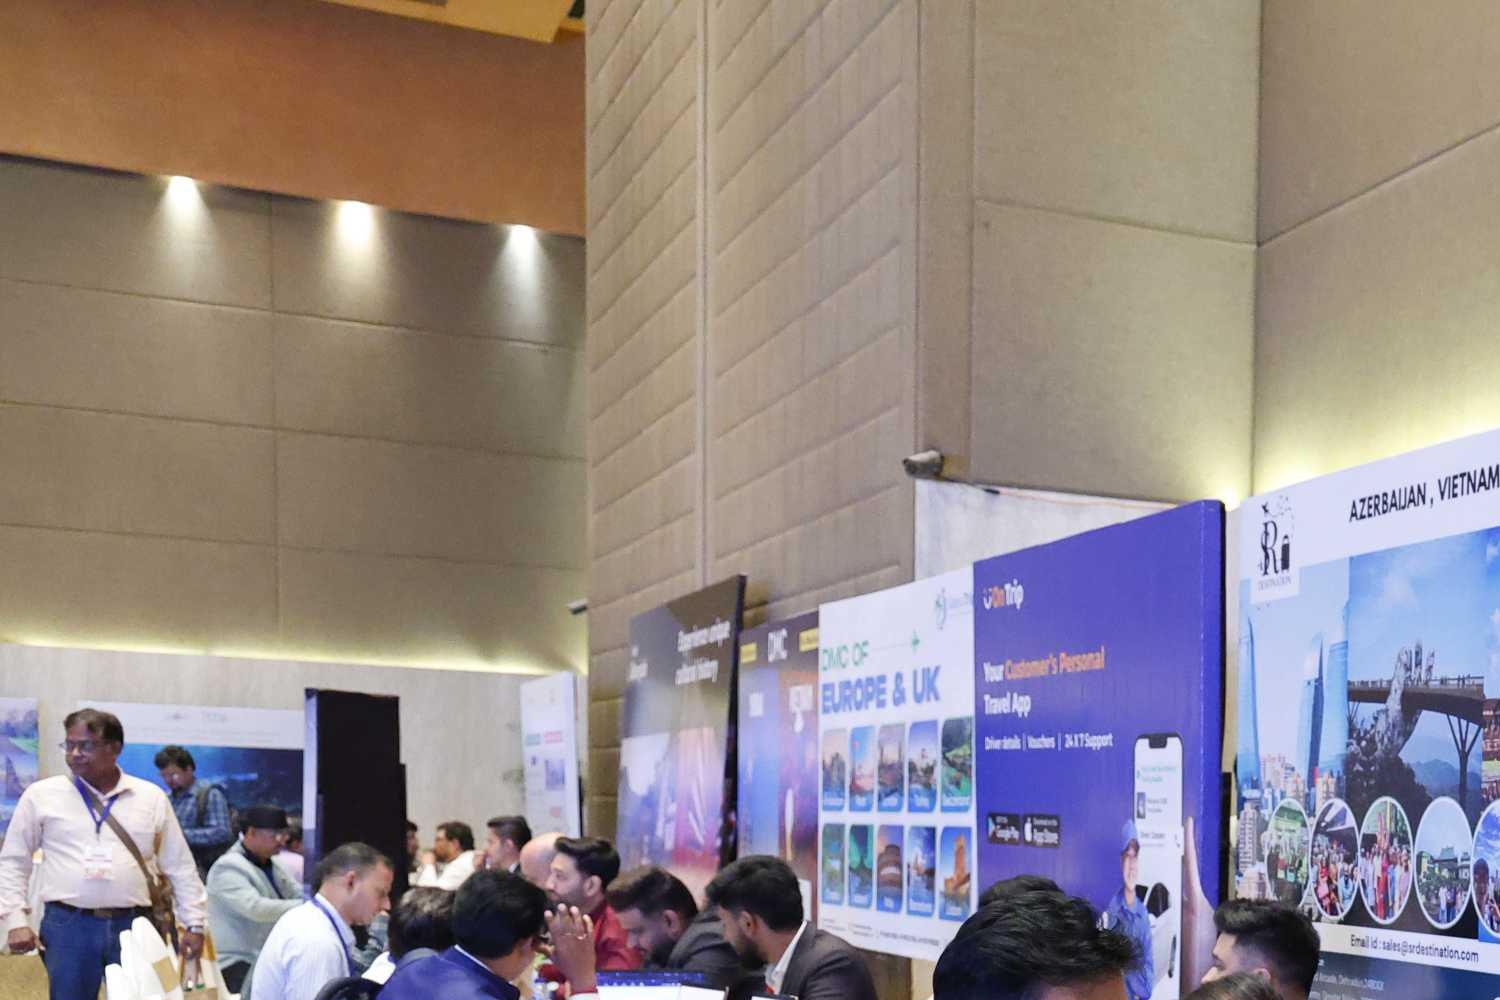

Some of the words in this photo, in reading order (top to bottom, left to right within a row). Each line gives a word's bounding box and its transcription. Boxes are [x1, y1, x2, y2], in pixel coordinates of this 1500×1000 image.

[1438, 464, 1500, 501] VIETNAM
[821, 644, 848, 671] DMC
[852, 640, 868, 666] OF
[822, 674, 887, 714] EUROPE
[893, 671, 906, 706] &
[913, 665, 940, 703] UK
[983, 692, 1011, 715] Travel
[1012, 692, 1031, 718] App
[1350, 934, 1369, 949] Email
